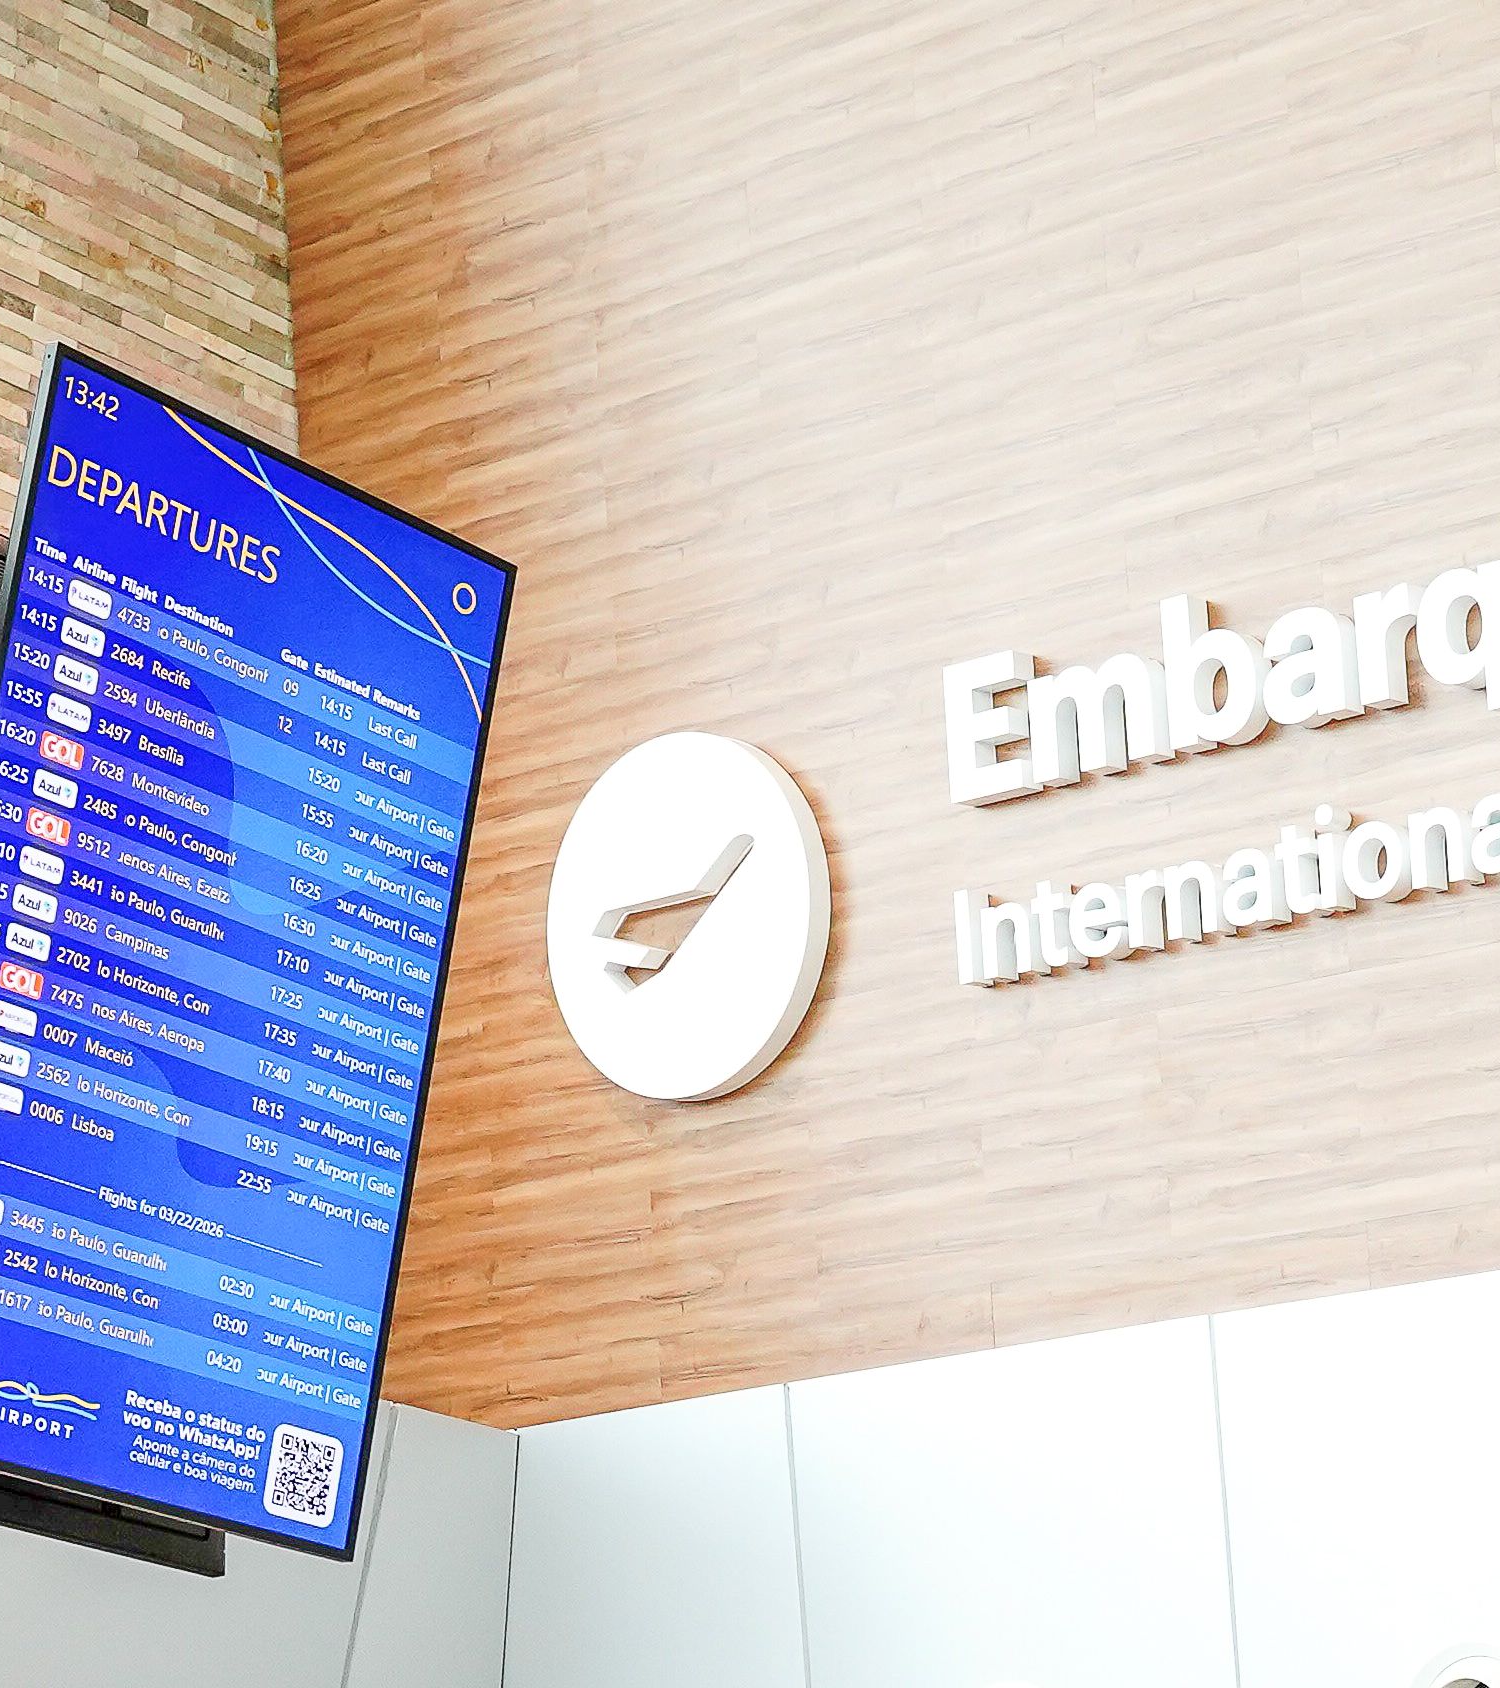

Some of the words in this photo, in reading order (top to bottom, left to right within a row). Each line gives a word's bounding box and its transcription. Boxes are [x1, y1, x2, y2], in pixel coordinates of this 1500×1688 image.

[65, 376, 119, 421] 13:42
[47, 444, 280, 584] DEPARTURES
[34, 536, 67, 563] Time
[72, 555, 116, 585] Airline
[121, 575, 158, 604] Flight
[164, 594, 233, 637] Destination
[280, 648, 308, 671] Gate
[314, 662, 371, 698] Estimated
[372, 688, 420, 721] Remarks
[28, 566, 64, 594] 14:15
[117, 607, 150, 632] 4733
[172, 629, 210, 660] Paulo,
[283, 678, 299, 696] 09
[321, 695, 352, 720] 14:15
[368, 716, 392, 739] Last
[394, 728, 417, 750] Call
[21, 604, 57, 632] 14:15
[110, 643, 144, 670] 2684
[151, 660, 190, 690] Recife
[277, 715, 292, 734] 12
[314, 731, 346, 756] 14:15
[361, 751, 386, 775] Last
[388, 764, 411, 785] Call
[6, 680, 43, 708] 15:55
[96, 718, 131, 744] 3497
[138, 734, 184, 766] Brasília
[13, 642, 50, 670] 15:20
[103, 681, 137, 707] 2594
[145, 697, 215, 740] Uberlândia
[375, 797, 418, 827] Airport
[426, 818, 454, 842] Gate
[0, 719, 36, 746] 16:20
[40, 735, 80, 771] GOL
[91, 755, 124, 782] 7628
[131, 772, 209, 816] Montevideo
[83, 794, 117, 820] 2485
[26, 811, 70, 847] GOL
[76, 832, 110, 858] 9512
[69, 870, 103, 895] 3441
[63, 908, 98, 933] 9026
[105, 924, 169, 960] Campinas
[56, 946, 91, 973] 2702
[0, 965, 43, 1000] GOL
[50, 984, 84, 1010] 7475
[43, 1023, 78, 1048] 0007
[85, 1037, 133, 1067] Maceió
[36, 1062, 70, 1086] 2562
[29, 1100, 64, 1125] 0006
[71, 1113, 114, 1142] Lisboa
[9, 1210, 45, 1234] 3445
[98, 1186, 137, 1210] Flights
[139, 1198, 157, 1216] for
[158, 1205, 224, 1238] 03/22/2026
[3, 1249, 38, 1274] 2542
[0, 1289, 32, 1311] 1617
[123, 1410, 151, 1429] voo
[154, 1420, 174, 1436] no
[178, 1423, 260, 1460] WhatsApp!
[125, 1389, 181, 1419] Receba
[184, 1410, 195, 1423] o
[197, 1412, 243, 1437] status
[245, 1424, 266, 1442] do
[129, 1450, 171, 1469] celular
[172, 1462, 181, 1473] e
[183, 1462, 207, 1480] boa
[210, 1471, 256, 1493] viagem.
[132, 1434, 179, 1458] Aponte
[181, 1449, 189, 1461] a
[191, 1451, 236, 1473] câmera
[238, 1463, 255, 1479] do
